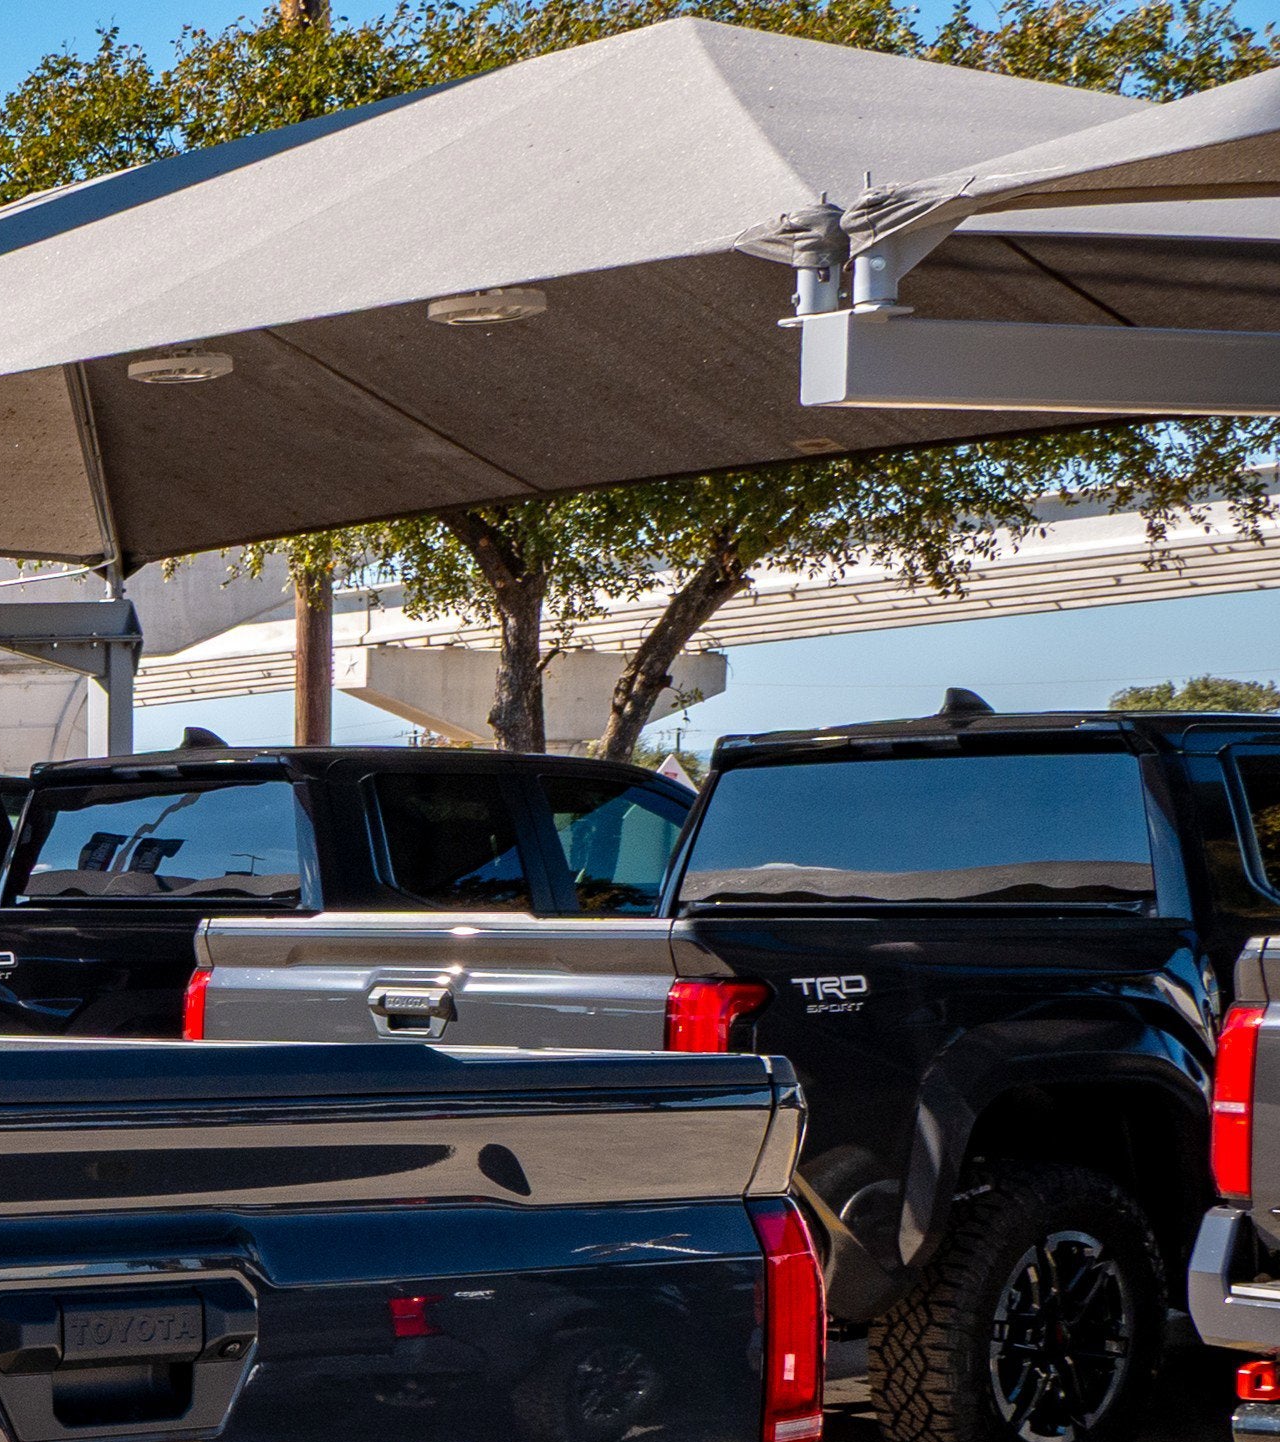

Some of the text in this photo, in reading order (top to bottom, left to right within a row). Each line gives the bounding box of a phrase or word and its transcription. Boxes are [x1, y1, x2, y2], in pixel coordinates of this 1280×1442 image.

[791, 975, 868, 1000] TRD
[806, 1002, 864, 1013] SPORT
[71, 1311, 198, 1347] TOYOTA
